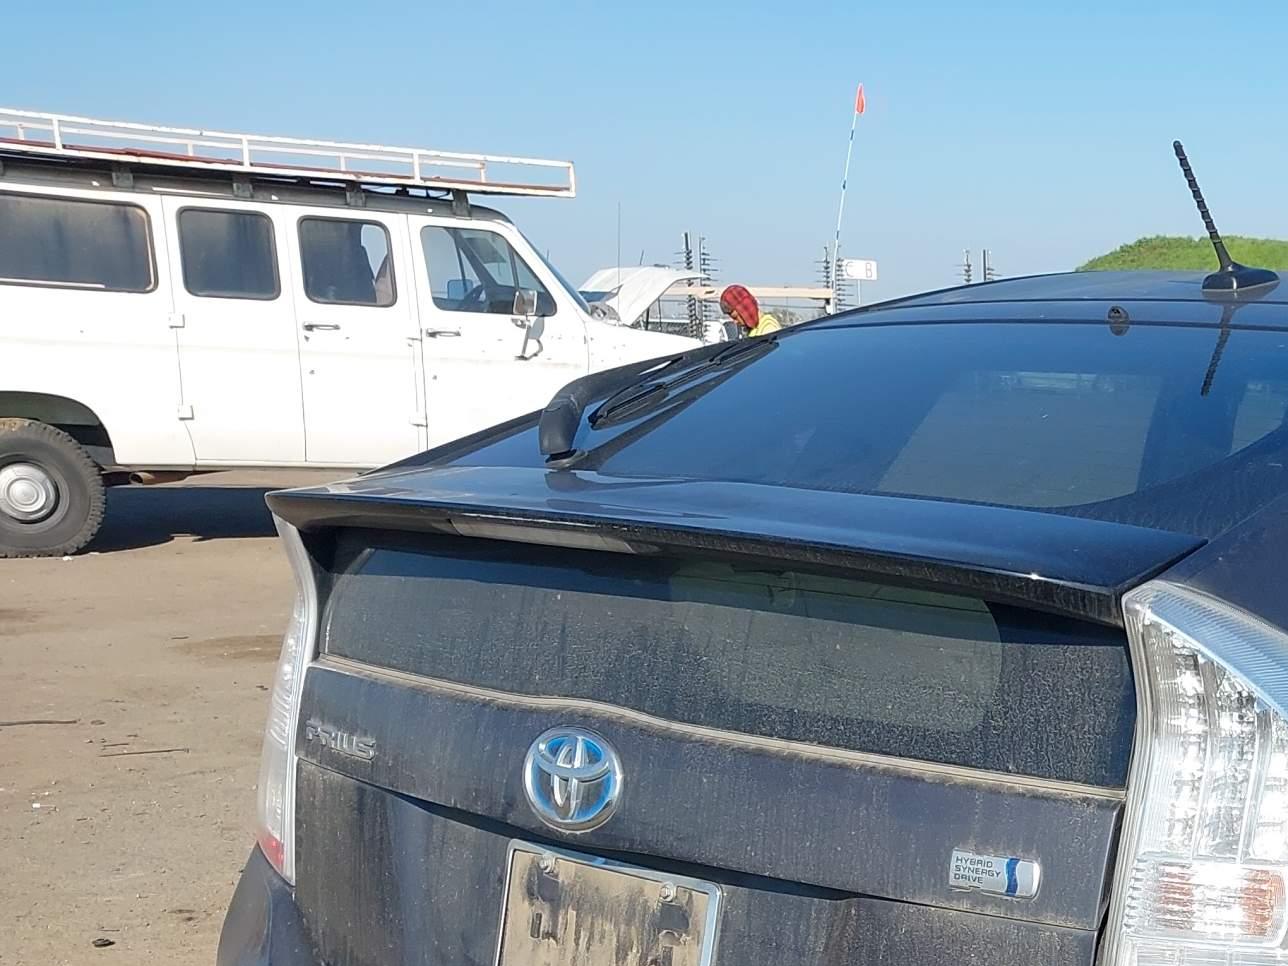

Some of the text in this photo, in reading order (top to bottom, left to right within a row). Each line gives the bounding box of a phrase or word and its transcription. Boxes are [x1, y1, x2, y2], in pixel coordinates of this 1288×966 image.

[305, 720, 377, 760] PRIUS
[955, 855, 993, 868] HYBRID
[954, 864, 1001, 878] SYNERGY
[953, 873, 984, 884] DRIVE
